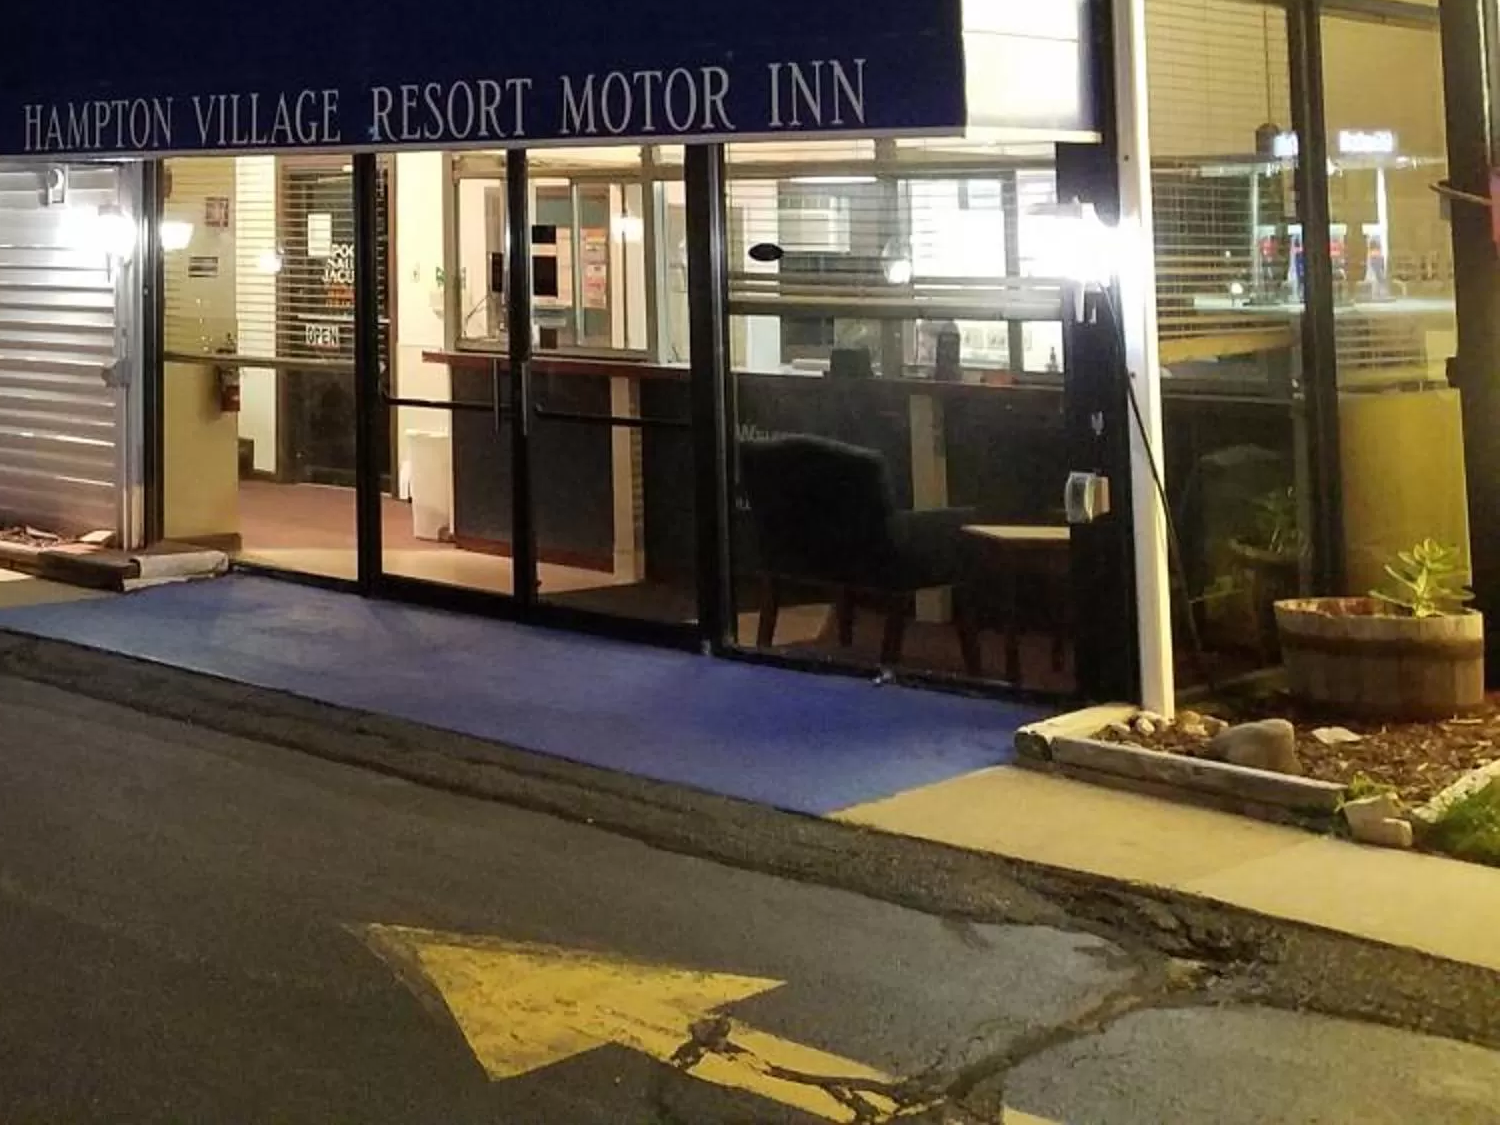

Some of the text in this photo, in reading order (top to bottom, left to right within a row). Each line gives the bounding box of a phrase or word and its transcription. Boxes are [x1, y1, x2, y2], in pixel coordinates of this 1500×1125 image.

[23, 59, 867, 152] HAMPTON VILLAGE RESORT MOTOR INN
[306, 324, 338, 346] OPEN
